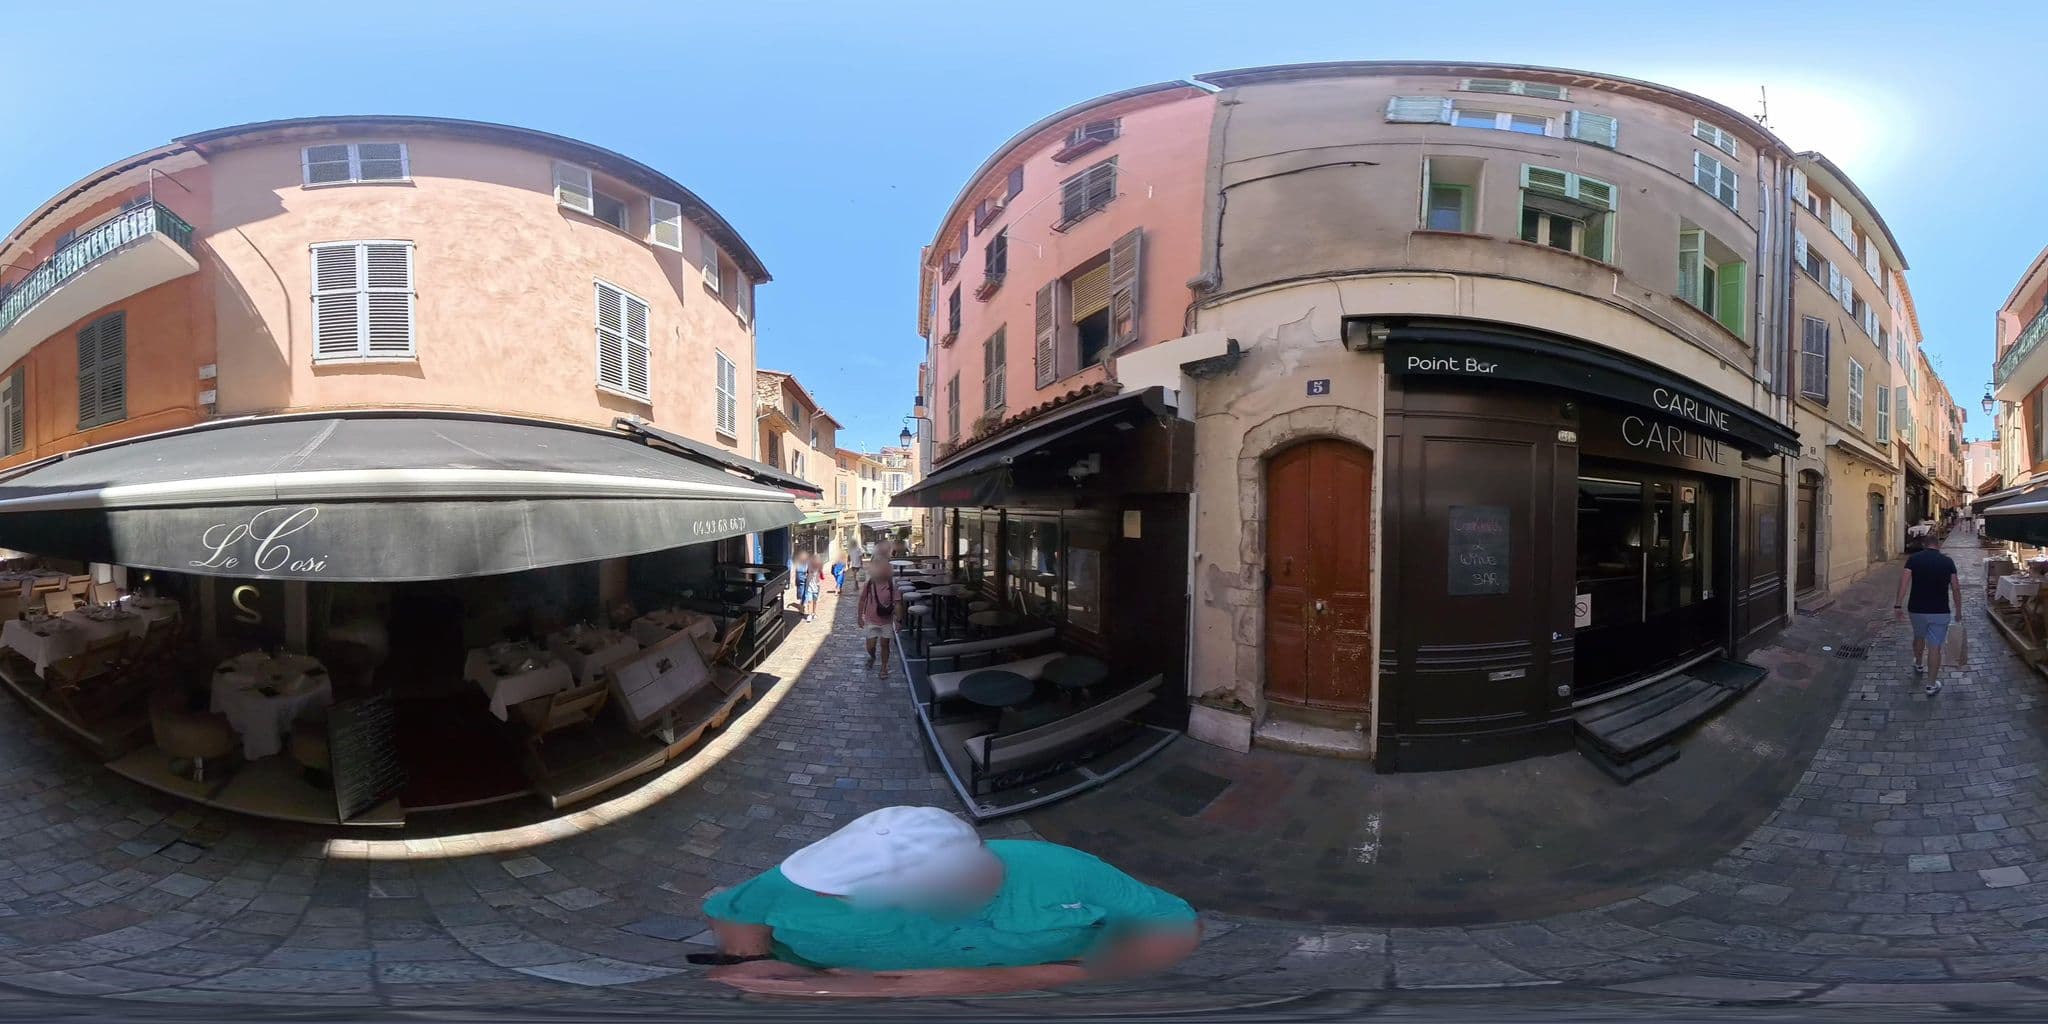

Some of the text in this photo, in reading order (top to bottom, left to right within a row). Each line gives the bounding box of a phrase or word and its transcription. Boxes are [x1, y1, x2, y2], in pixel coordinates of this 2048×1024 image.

[1407, 356, 1498, 373] Point Bar
[1312, 380, 1324, 394] 5
[1653, 388, 1730, 432] CARLINE
[1621, 415, 1728, 465] CARLINE
[188, 506, 328, 572] Le Cosi
